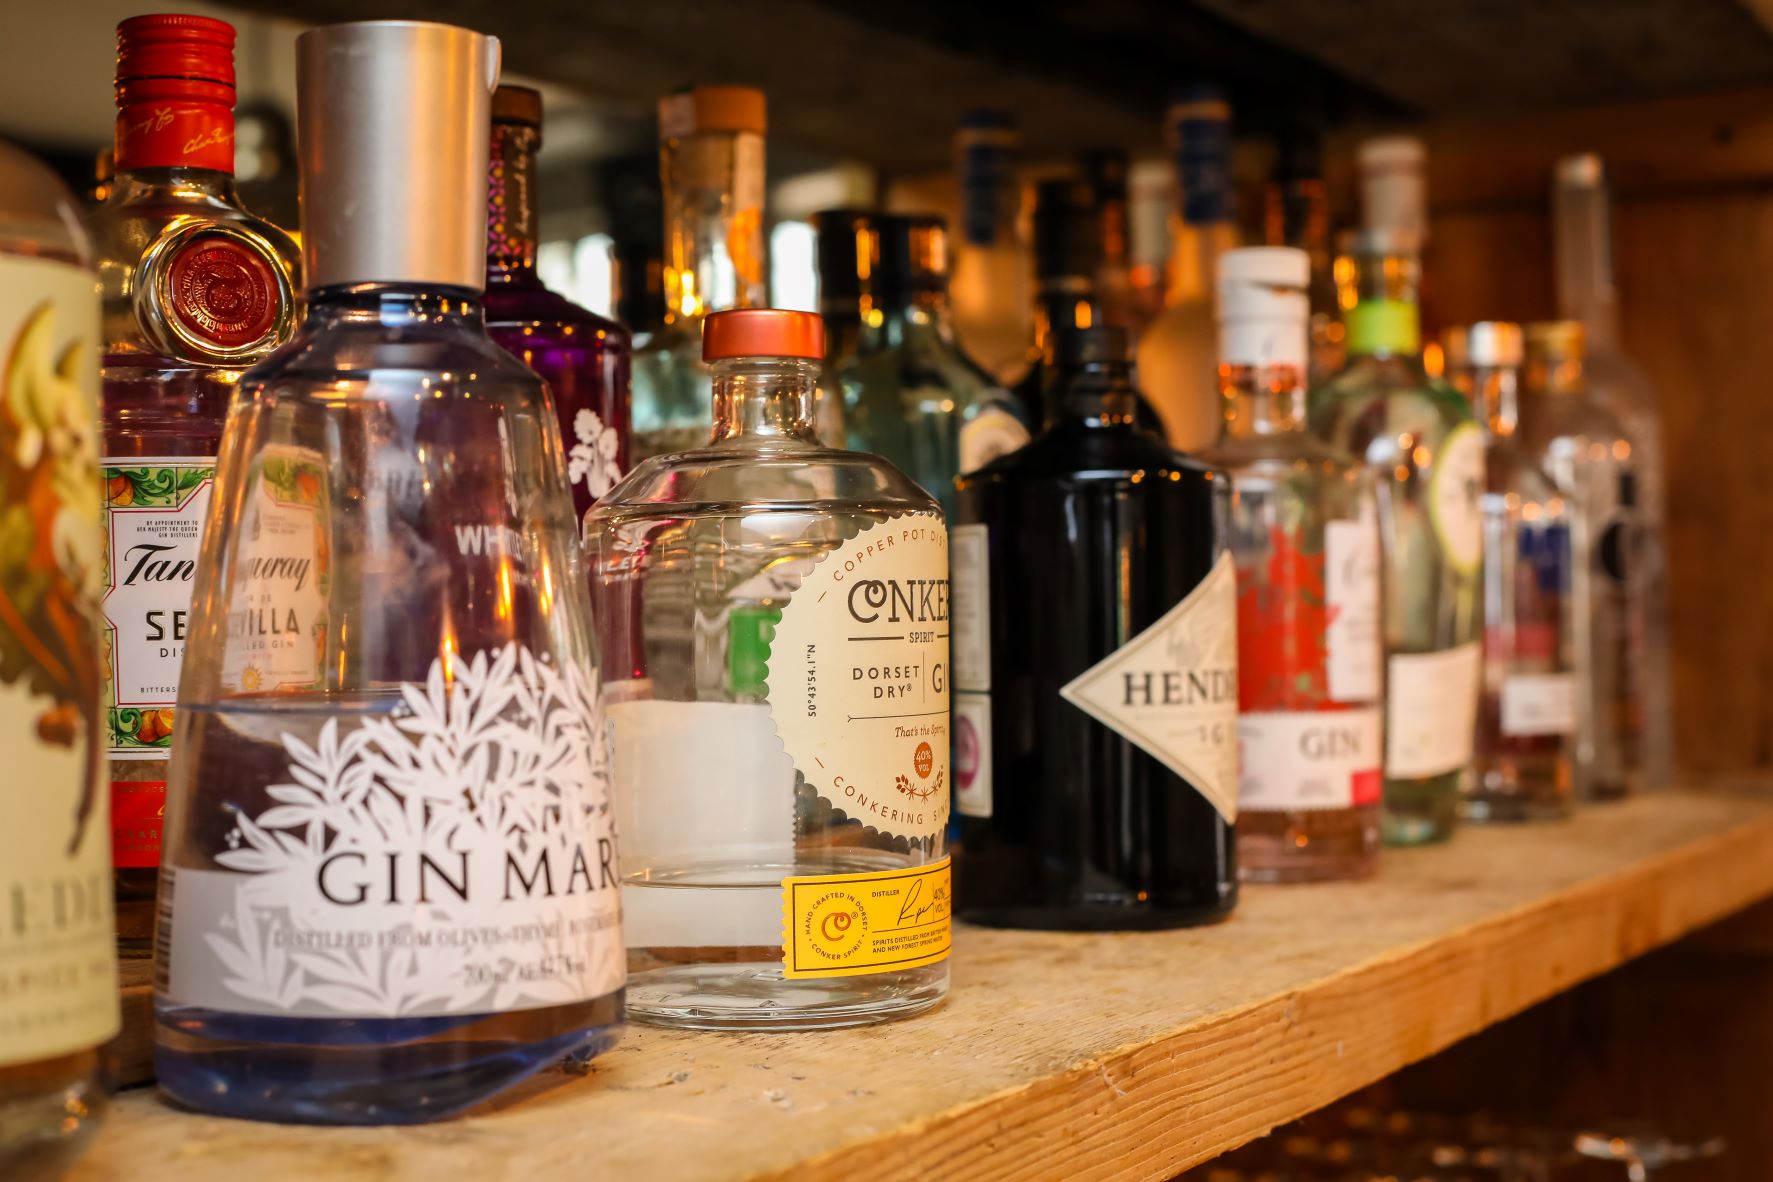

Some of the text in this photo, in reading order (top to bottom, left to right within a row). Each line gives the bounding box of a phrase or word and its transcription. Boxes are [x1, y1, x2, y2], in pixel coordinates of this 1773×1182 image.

[833, 534, 896, 581] COPPER
[902, 528, 926, 542] POT
[271, 639, 295, 649] GIN
[909, 631, 935, 643] SPIRIT
[852, 665, 920, 681] DORSET
[895, 725, 919, 738] That's
[920, 724, 930, 736] the
[1299, 726, 1362, 763] GIN
[915, 750, 931, 762] 40%
[833, 775, 924, 825] CONKERING
[317, 850, 470, 906] GIN
[871, 889, 900, 898] DISTILLER
[805, 892, 868, 935] HAND CRAFTED IN DORSET
[872, 938, 894, 947] SPIRITS
[894, 934, 919, 943] DISTILLED
[872, 946, 886, 954] AND
[887, 944, 901, 952] NEW
[901, 941, 919, 950] FOREST
[811, 939, 863, 960] CONKER SPIRIT
